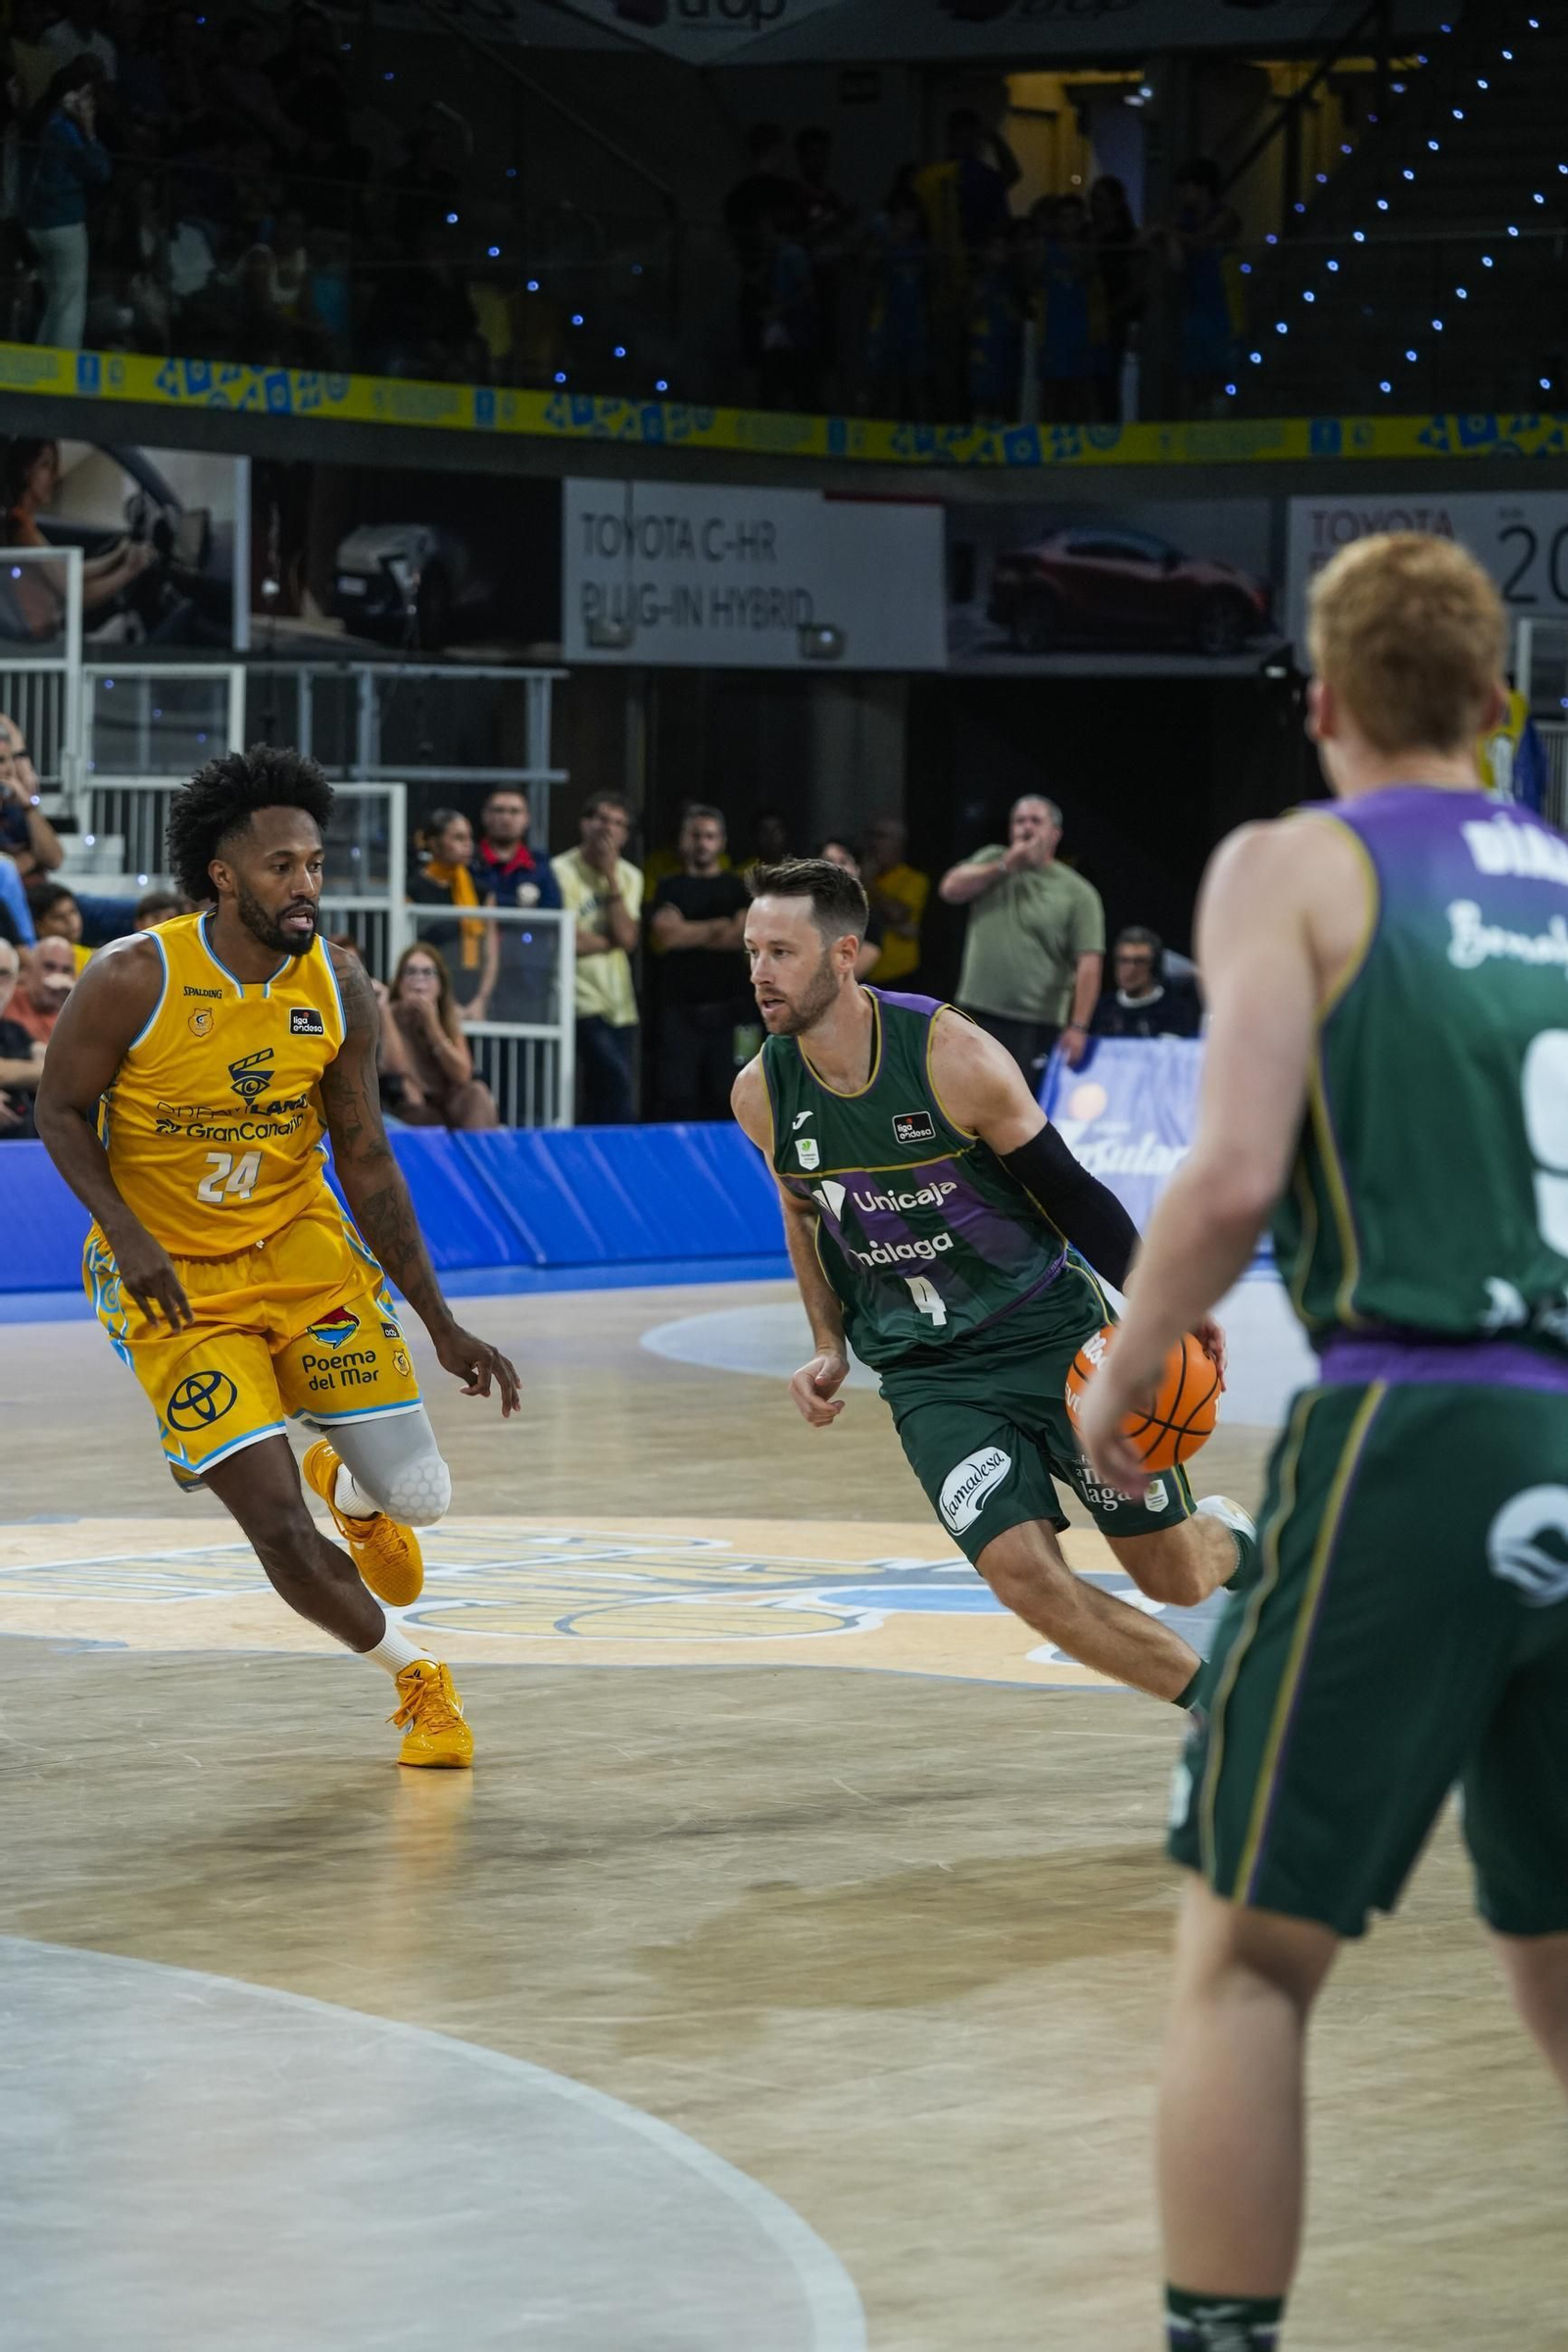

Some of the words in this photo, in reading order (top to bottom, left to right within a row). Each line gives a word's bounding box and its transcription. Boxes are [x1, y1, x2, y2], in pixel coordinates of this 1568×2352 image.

[581, 513, 695, 560] TOYOTA
[700, 517, 778, 563] C-HR
[581, 580, 704, 628] PLUG-IN
[711, 586, 815, 631] HYBRID
[183, 985, 222, 1000] SPALDING
[293, 1015, 308, 1025] liga
[293, 1024, 322, 1033] endesa
[897, 1123, 912, 1133] liga
[900, 1128, 932, 1140] endesa
[196, 1151, 263, 1202] 24
[853, 1182, 957, 1212] Unicaja
[904, 1276, 948, 1326] 4
[302, 1349, 377, 1374] Poema
[309, 1373, 335, 1391] del
[340, 1368, 379, 1387] Mar
[941, 1451, 1004, 1530] famadesa
